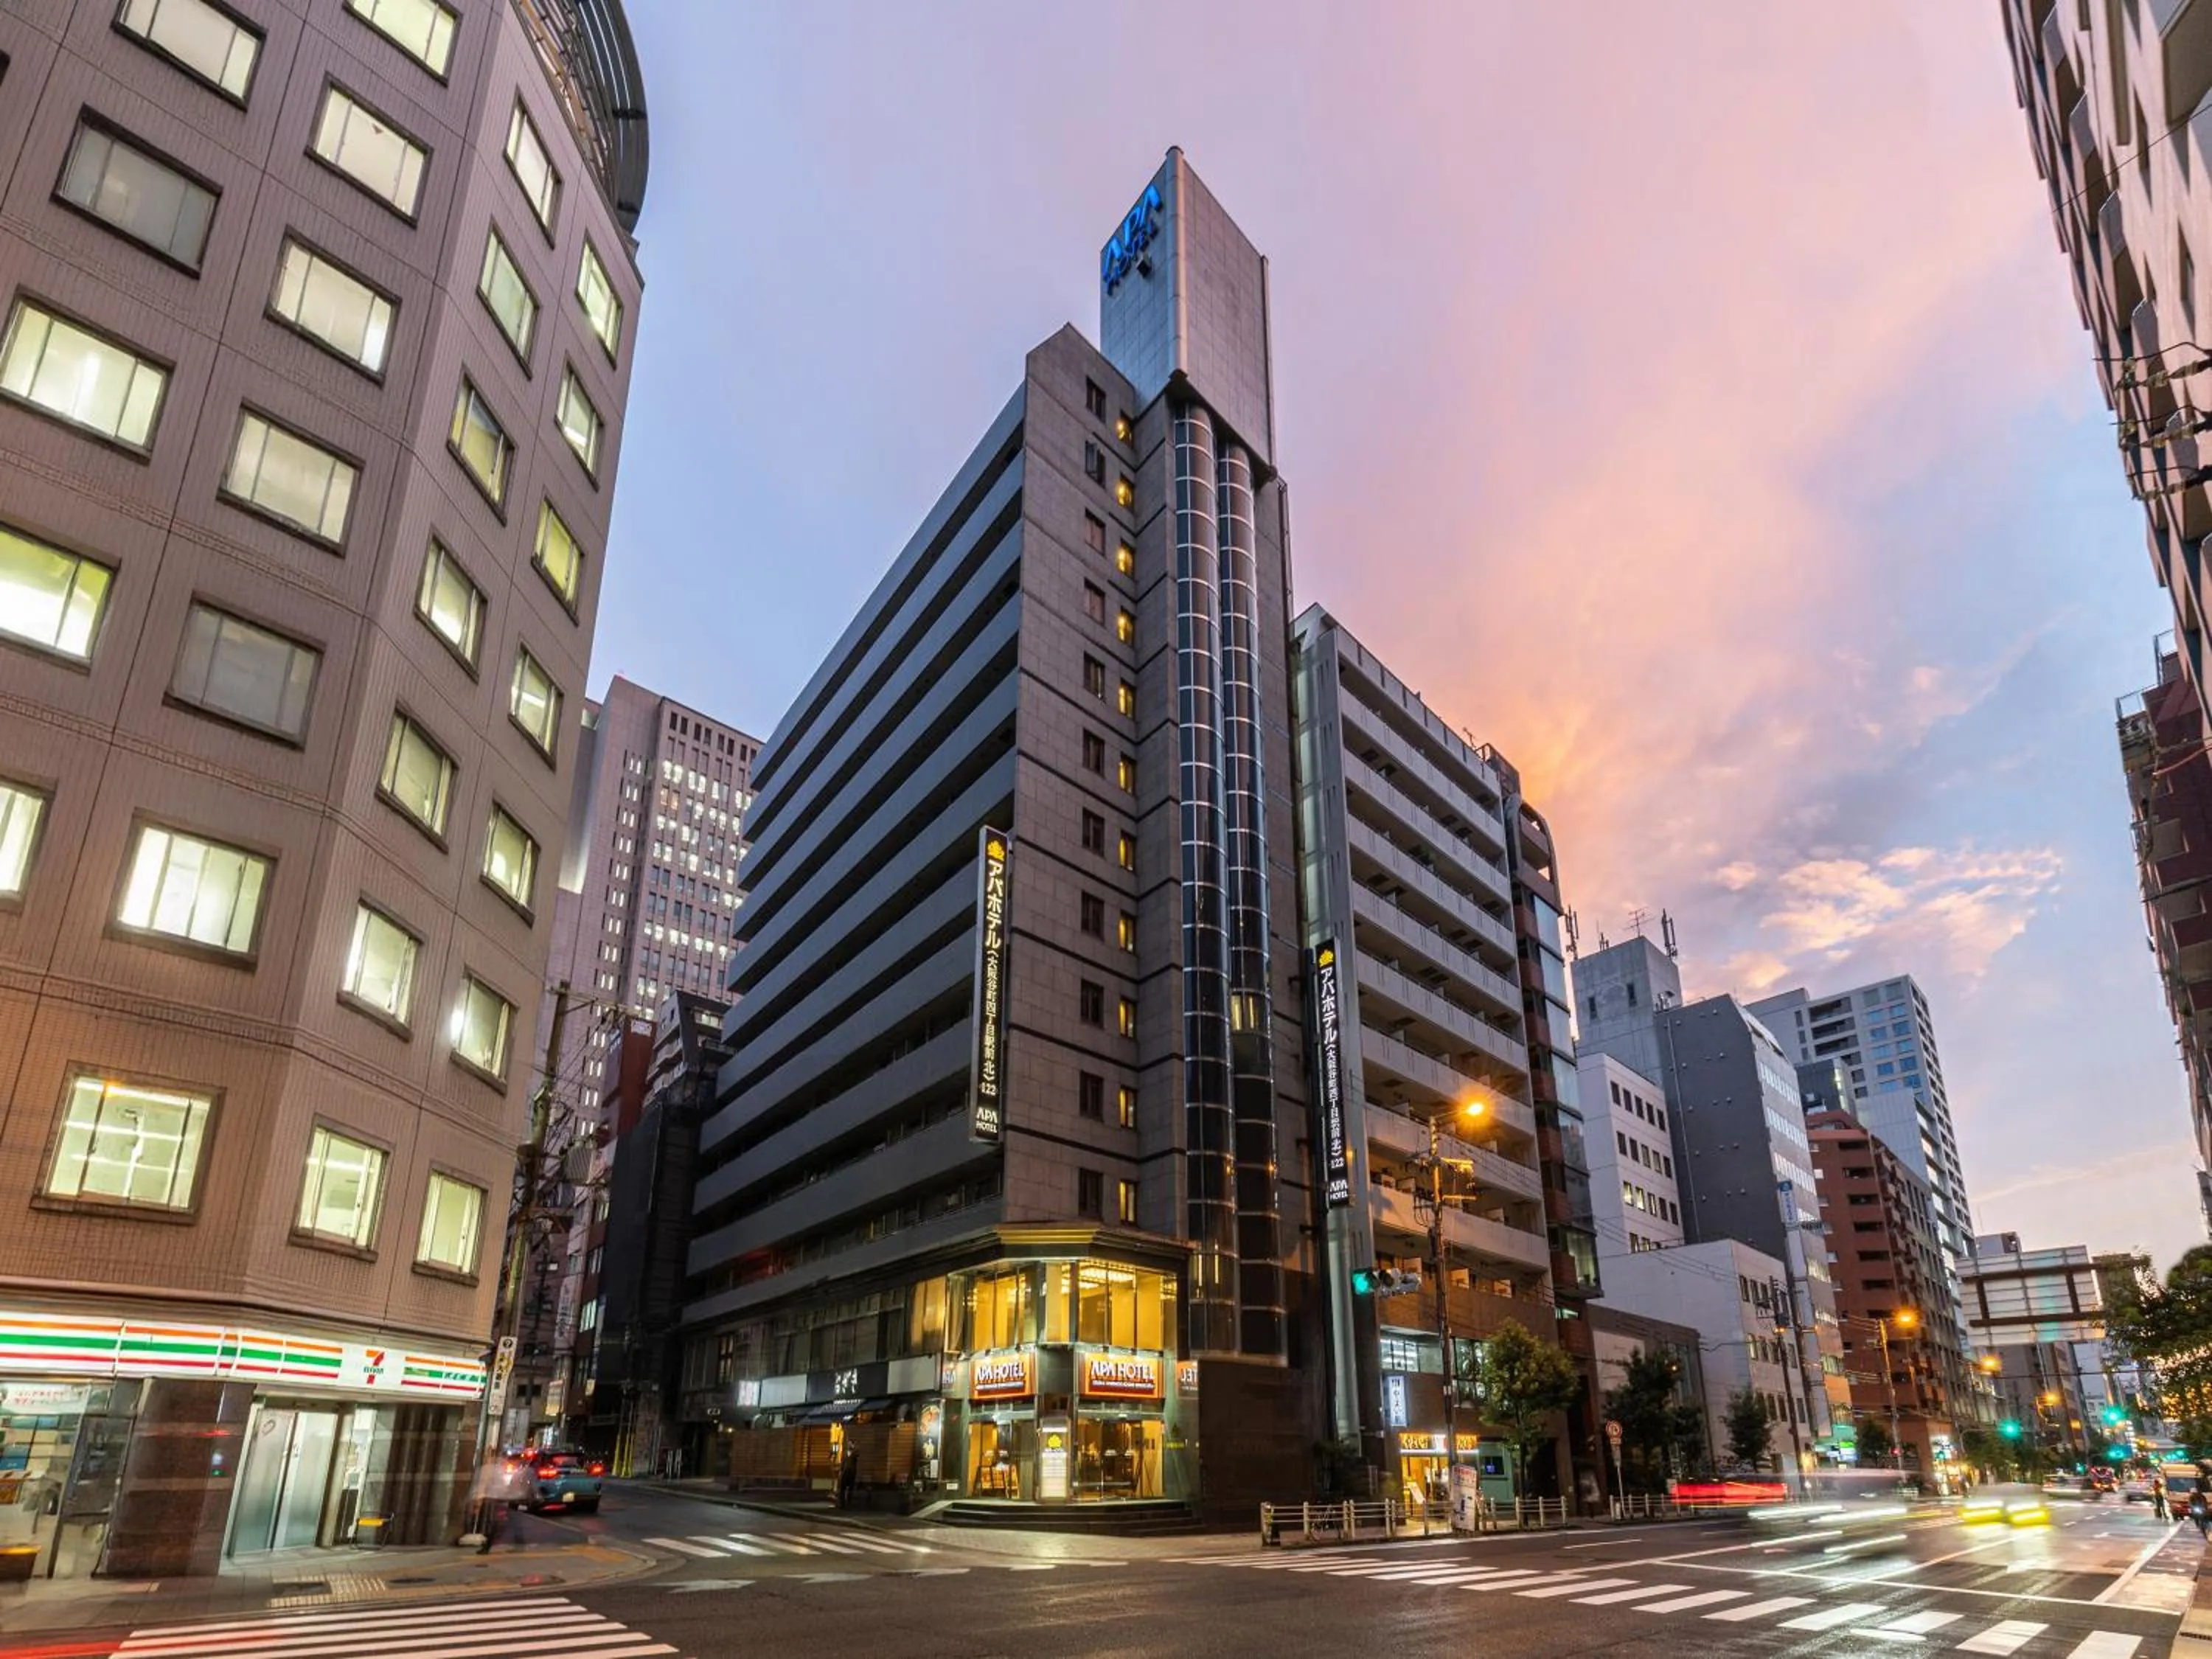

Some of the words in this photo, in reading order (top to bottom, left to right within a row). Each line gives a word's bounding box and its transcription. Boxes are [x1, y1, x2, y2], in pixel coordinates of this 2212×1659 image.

[976, 1107, 998, 1124] APA
[975, 1120, 998, 1133] HOTEL
[1329, 1179, 1348, 1192] APA
[975, 1363, 993, 1381] APA
[992, 1360, 1025, 1380] HOTEL
[1091, 1360, 1116, 1377] APA
[1116, 1362, 1155, 1380] HOTEL
